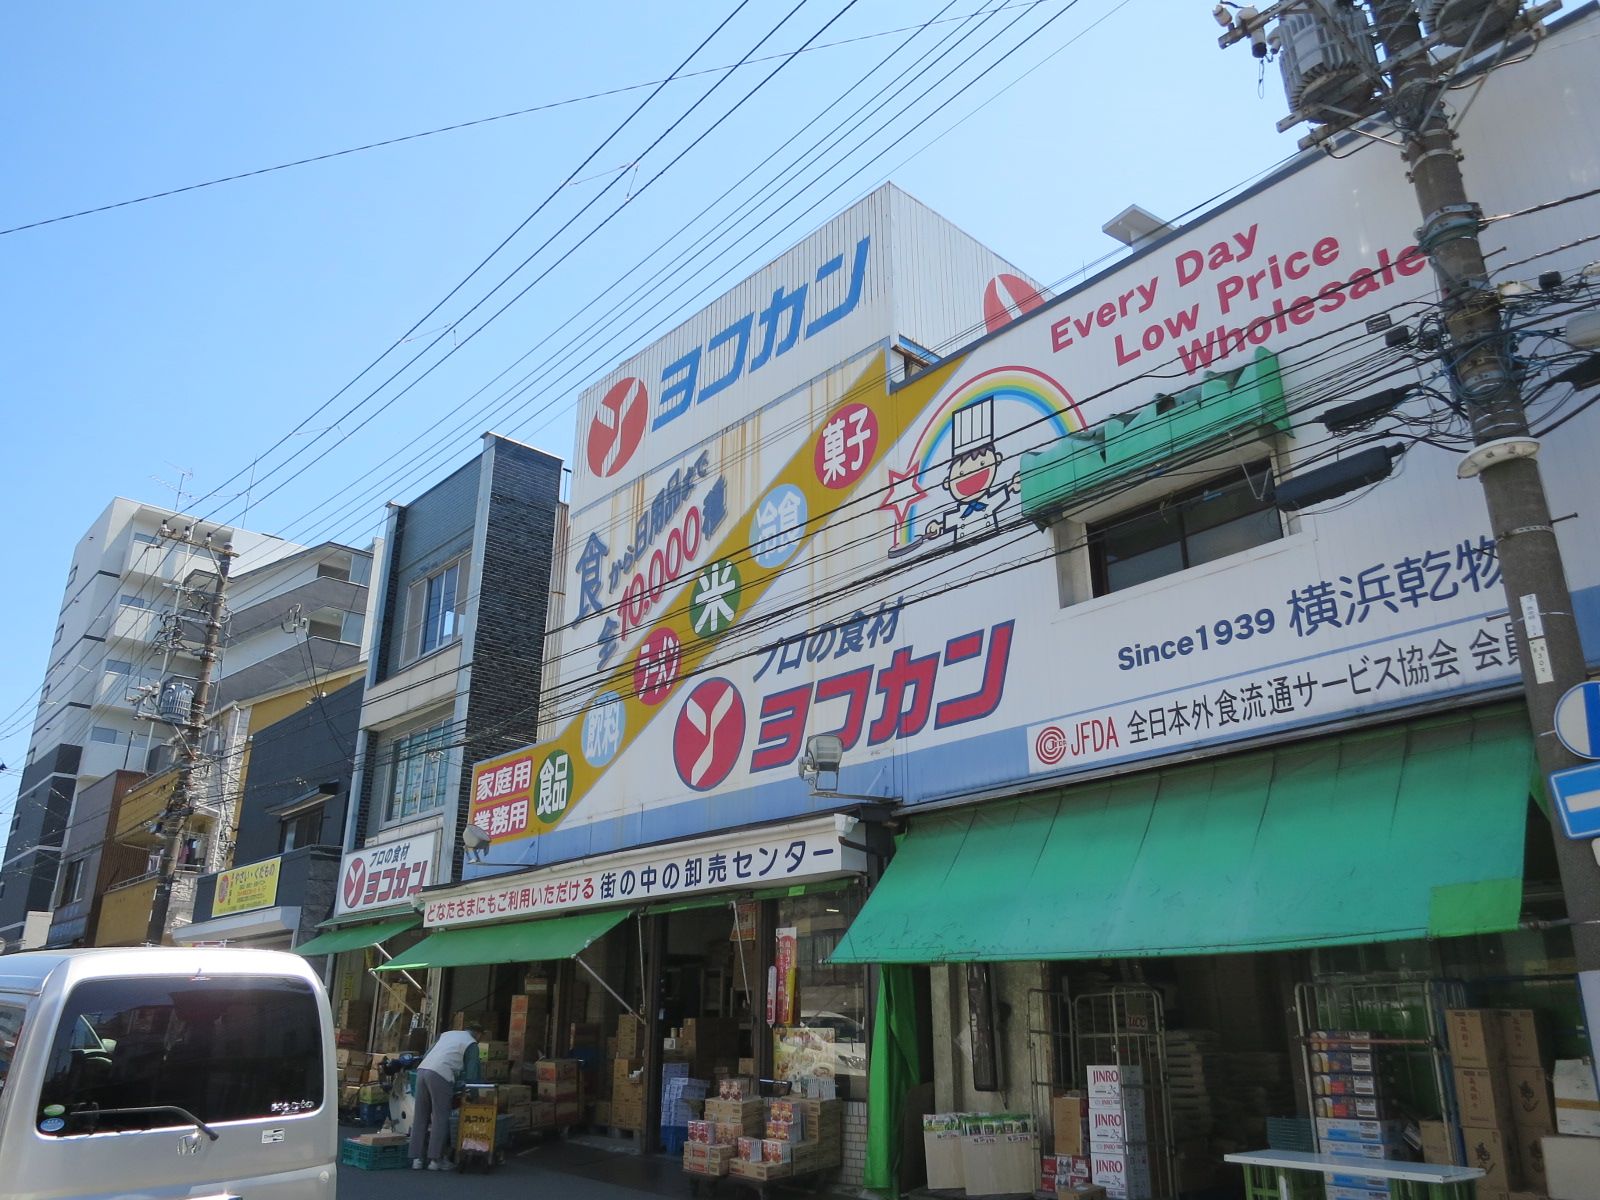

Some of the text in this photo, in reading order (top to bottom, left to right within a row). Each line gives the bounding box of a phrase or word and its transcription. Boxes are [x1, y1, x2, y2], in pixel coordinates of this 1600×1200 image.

[1050, 223, 1260, 354] Every Day
[1113, 236, 1340, 368] Low Price
[1177, 242, 1428, 376] Wholesale
[652, 236, 870, 432] ヨコカン
[821, 407, 872, 487] 菓子
[756, 491, 801, 563] 冷食
[694, 560, 736, 633] 米
[1286, 535, 1503, 639] 横浜乾物
[752, 596, 905, 684] プロの食材
[586, 701, 621, 760] 飲料
[749, 618, 1016, 774] ヨコカン
[1070, 716, 1120, 756] JFDA
[1127, 638, 1460, 745] 全日本外食流通サービス協会
[475, 759, 532, 801] 家庭用
[537, 753, 569, 816] 食品
[474, 800, 529, 836] 業務用
[363, 860, 428, 905] ヨコカン
[369, 842, 411, 868] プロの食材
[426, 840, 834, 923] どなたさまにもご利用いただける 街の中の卸売センター
[1092, 1069, 1119, 1085] JINRO
[1095, 1113, 1122, 1129] JINRO
[1096, 1160, 1123, 1175] JINRO
